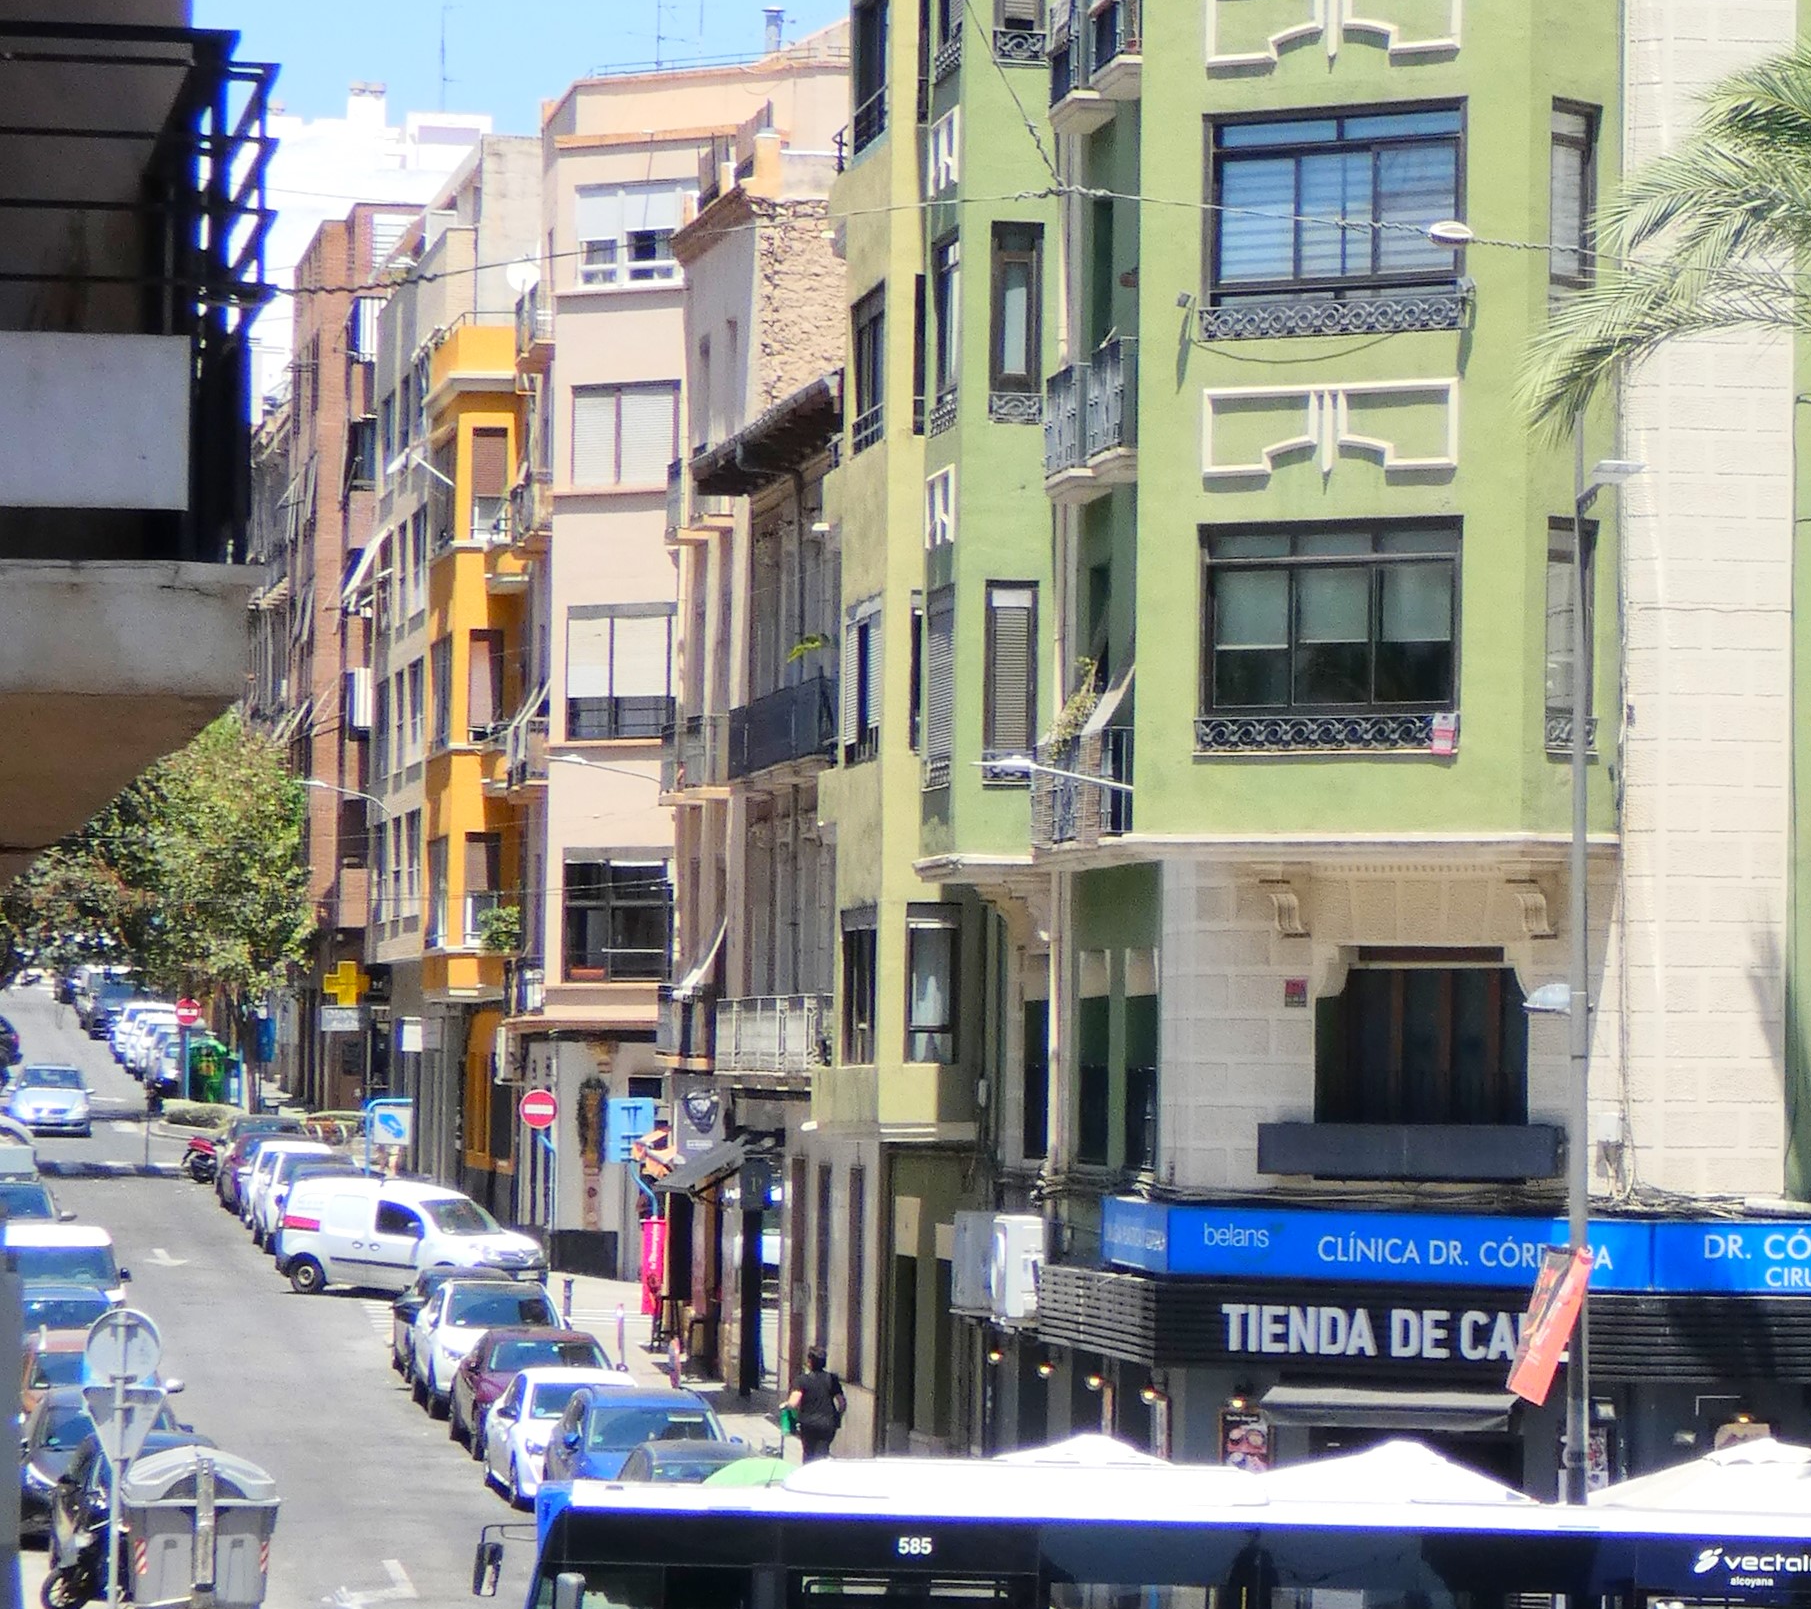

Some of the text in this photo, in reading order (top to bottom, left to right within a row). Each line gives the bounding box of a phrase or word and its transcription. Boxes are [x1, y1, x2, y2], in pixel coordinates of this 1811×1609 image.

[1203, 1222, 1270, 1248] belans
[1703, 1233, 1752, 1261] DR.
[1317, 1231, 1613, 1270] CLÍNICA DR. CÓRA
[1221, 1303, 1570, 1363] TIENDA DE CA
[897, 1537, 933, 1555] 585
[1729, 1576, 1774, 1589] alcoyana
